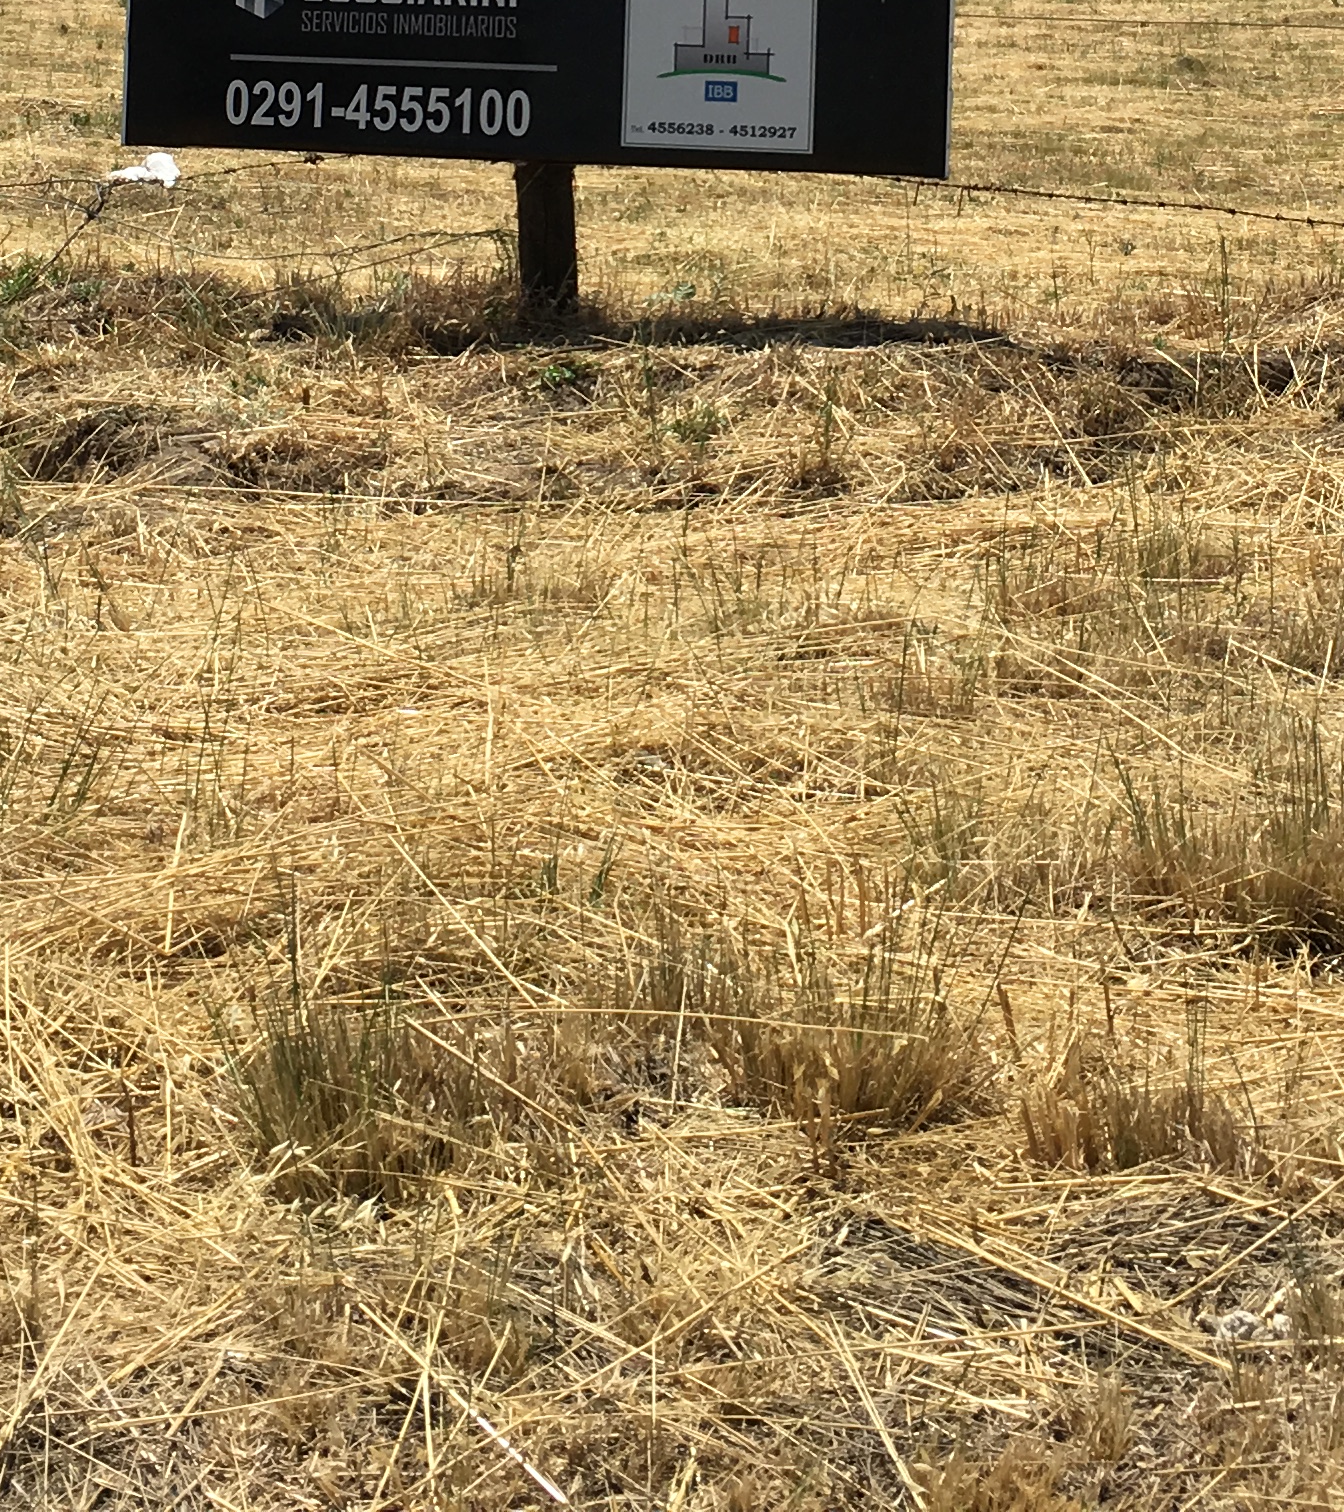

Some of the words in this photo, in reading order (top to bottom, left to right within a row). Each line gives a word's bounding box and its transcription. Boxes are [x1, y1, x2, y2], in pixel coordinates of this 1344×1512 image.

[301, 10, 388, 34] SERVICIOS
[393, 13, 517, 38] INMOBILIARIOS
[707, 84, 734, 99] IBB
[226, 79, 531, 137] 0291-4555100
[647, 121, 714, 136] 4556238
[729, 125, 798, 139] 4512927
